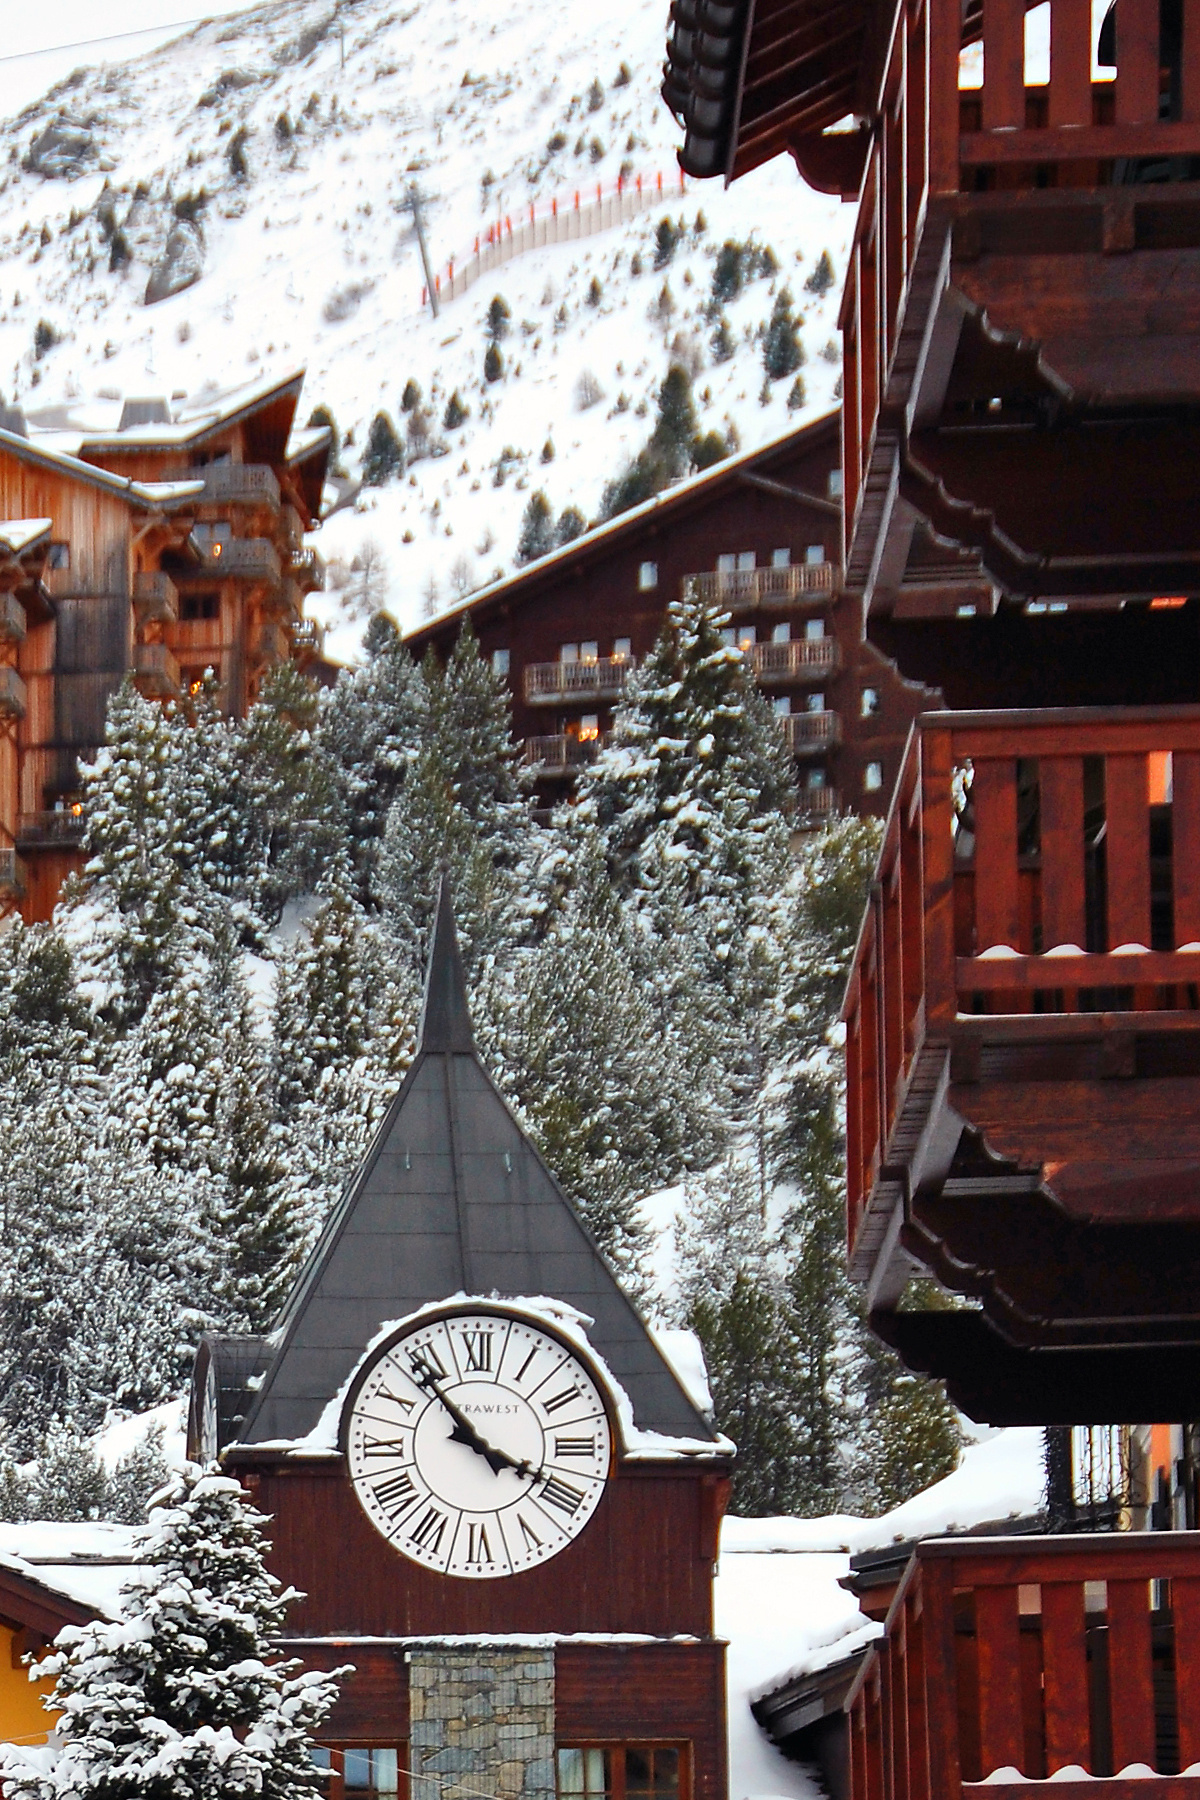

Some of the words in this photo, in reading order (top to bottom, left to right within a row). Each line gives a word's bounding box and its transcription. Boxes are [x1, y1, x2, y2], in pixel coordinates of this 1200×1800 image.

[460, 1331, 495, 1372] XII
[375, 1382, 417, 1416] X
[541, 1383, 584, 1415] II
[555, 1435, 595, 1458] III
[466, 1522, 495, 1563] VI
[517, 1513, 545, 1553] V
